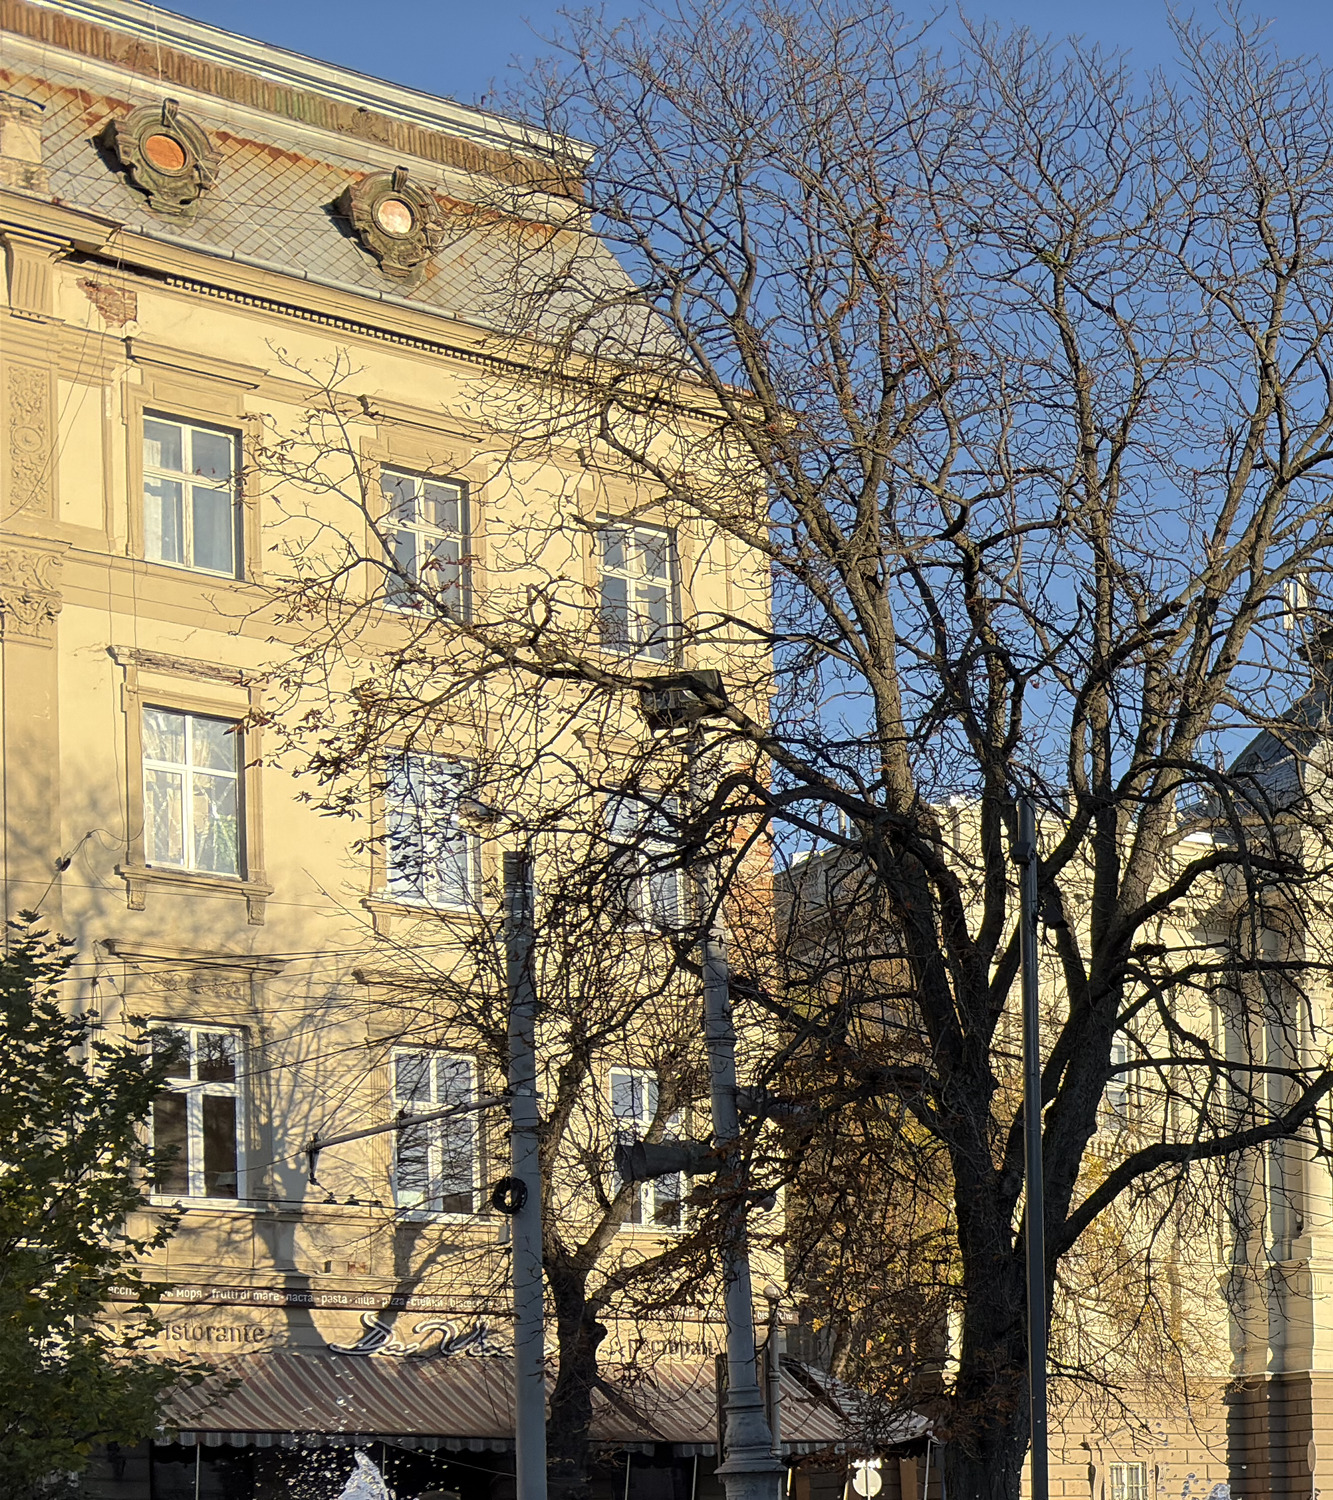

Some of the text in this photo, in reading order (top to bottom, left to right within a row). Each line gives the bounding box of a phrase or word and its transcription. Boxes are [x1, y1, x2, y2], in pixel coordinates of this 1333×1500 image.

[176, 1289, 202, 1301] моря
[211, 1287, 240, 1300] frutti
[242, 1288, 251, 1300] di
[253, 1290, 280, 1302] mare
[285, 1293, 314, 1303] паста
[321, 1293, 348, 1306] pasta
[155, 1323, 268, 1344] istorante
